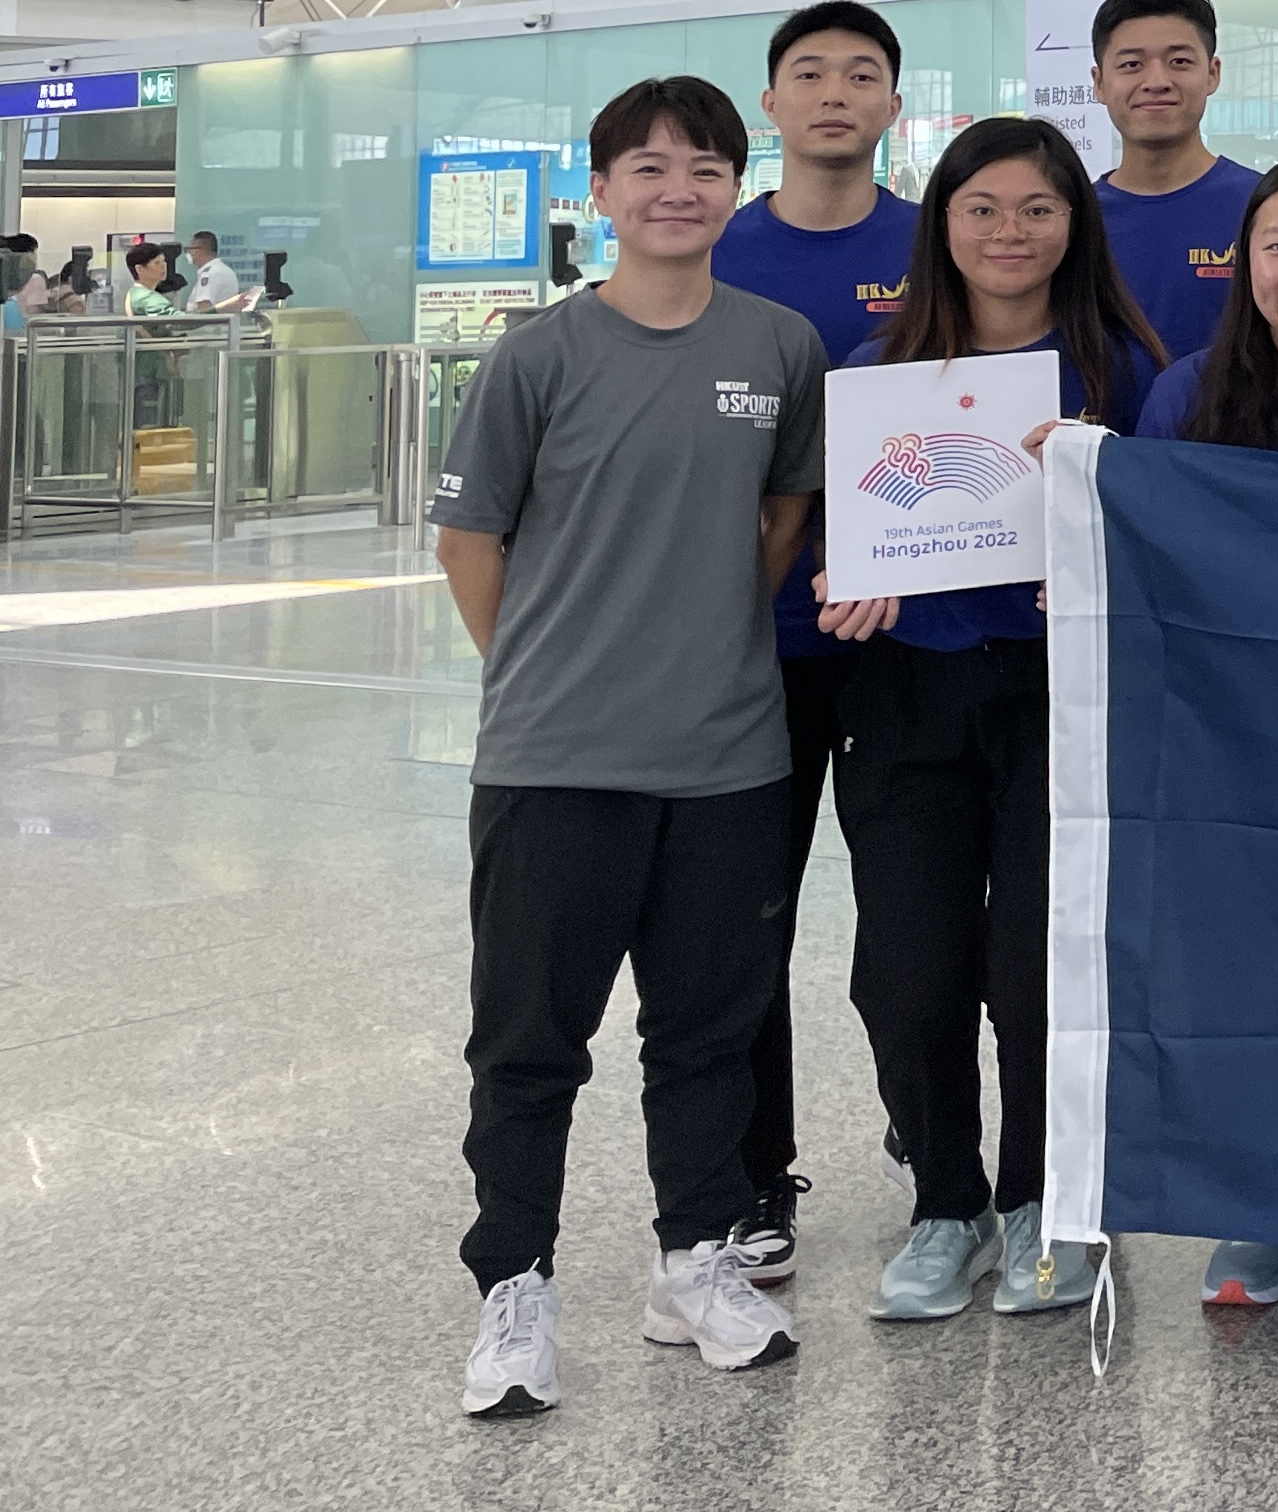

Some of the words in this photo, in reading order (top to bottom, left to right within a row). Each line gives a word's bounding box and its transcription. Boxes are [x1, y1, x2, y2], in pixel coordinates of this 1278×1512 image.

[730, 393, 780, 416] SPORTS
[884, 527, 912, 539] 19th
[917, 523, 953, 536] Asian
[957, 519, 1003, 532] Games
[873, 538, 967, 559] Hangzhou
[974, 531, 1017, 549] 2022
